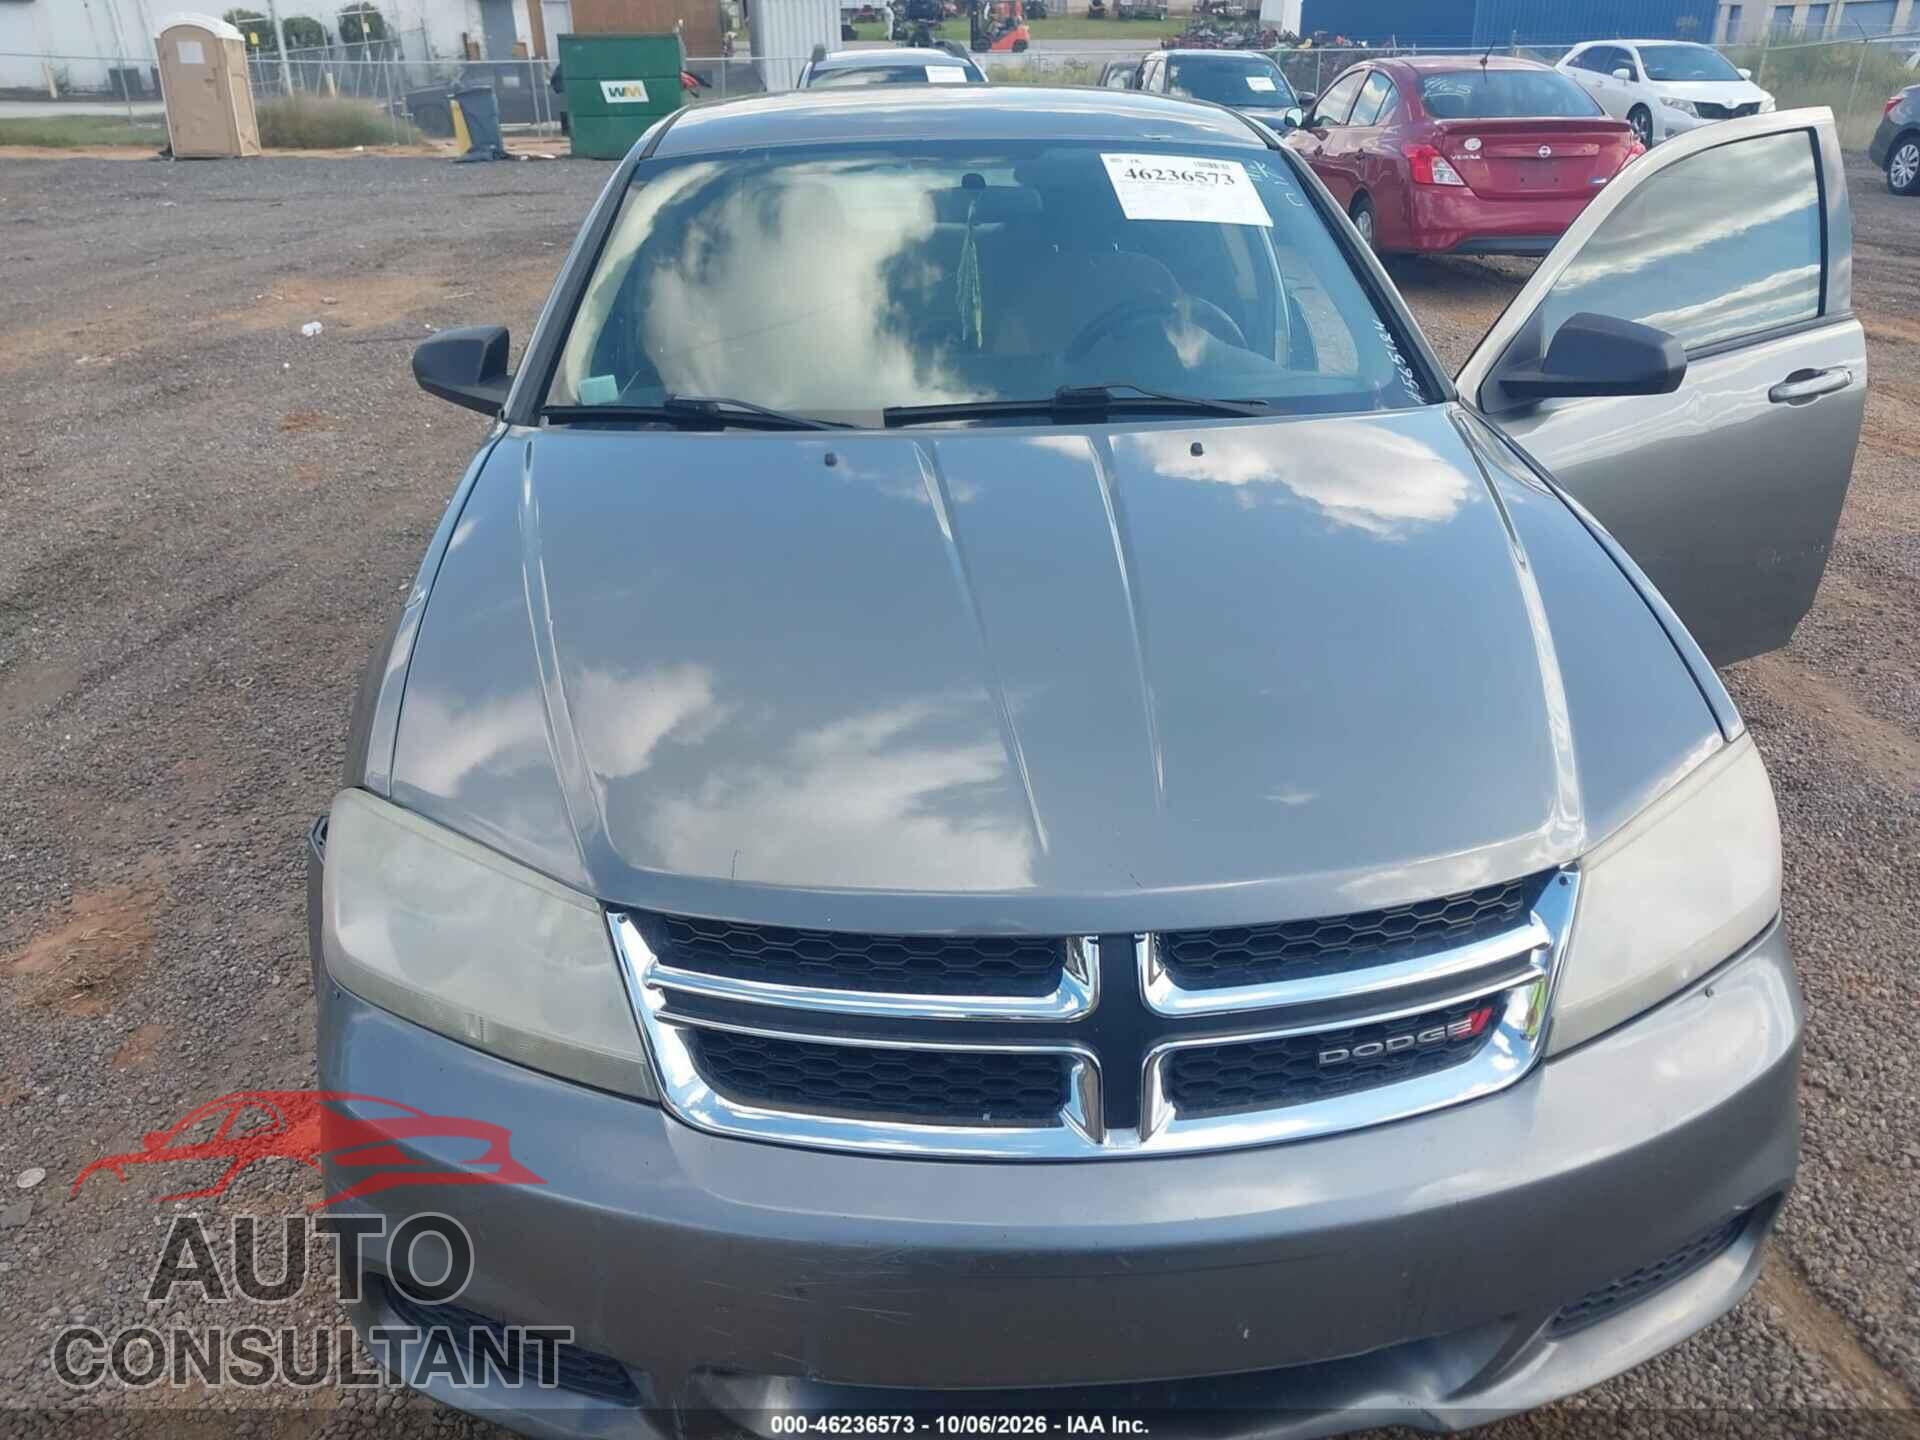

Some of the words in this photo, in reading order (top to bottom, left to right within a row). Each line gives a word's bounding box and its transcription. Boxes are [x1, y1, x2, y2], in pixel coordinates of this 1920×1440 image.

[608, 87, 643, 97] WM
[1124, 168, 1235, 186] 46236573
[1319, 1018, 1472, 1064] DODGE
